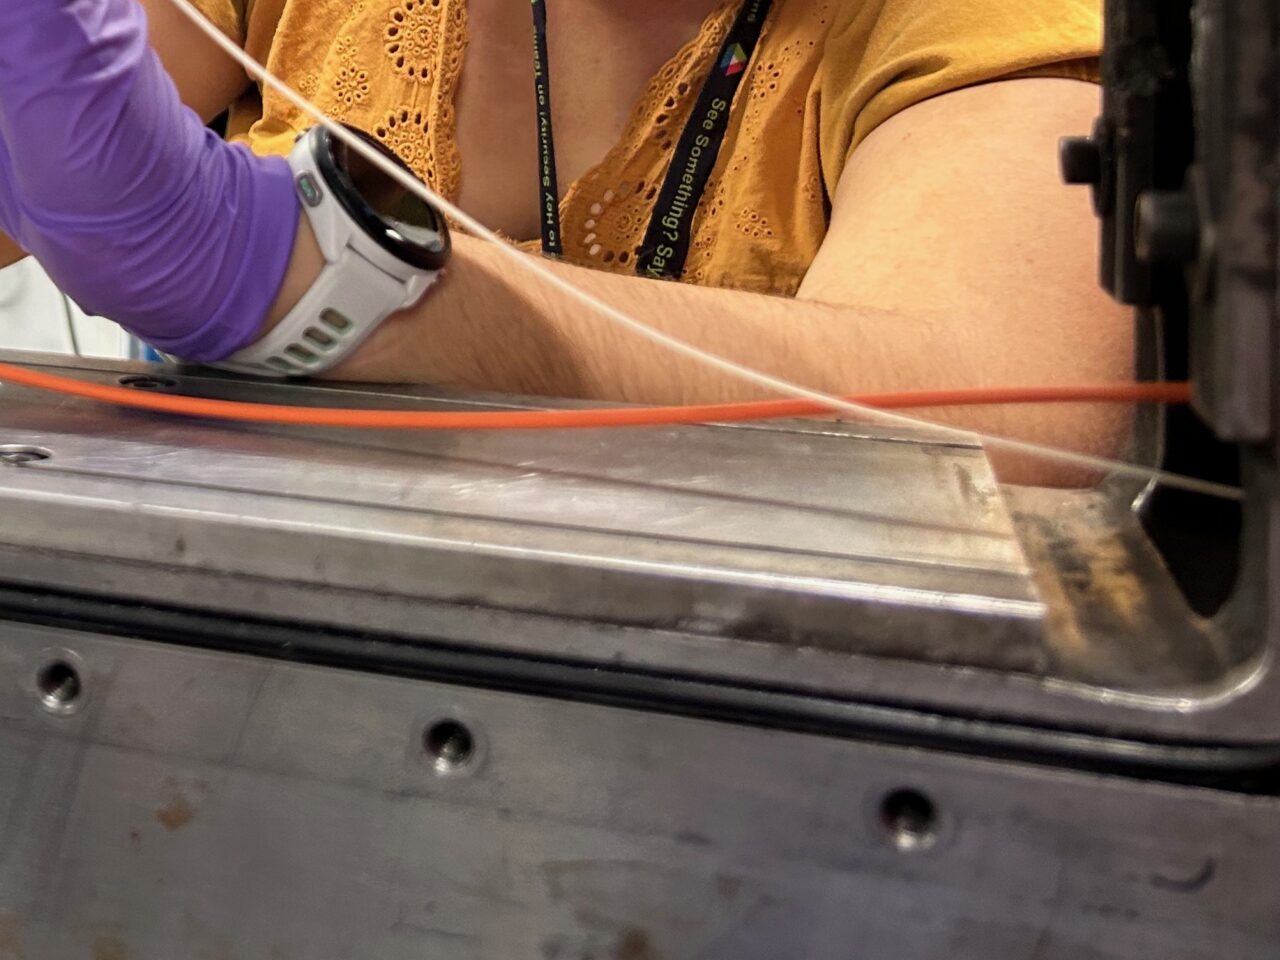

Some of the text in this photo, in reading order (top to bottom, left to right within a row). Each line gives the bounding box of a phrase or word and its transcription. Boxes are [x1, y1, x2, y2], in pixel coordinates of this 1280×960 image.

[536, 84, 546, 107] on
[646, 97, 727, 278] See Something? Say
[545, 191, 555, 225] Hey
